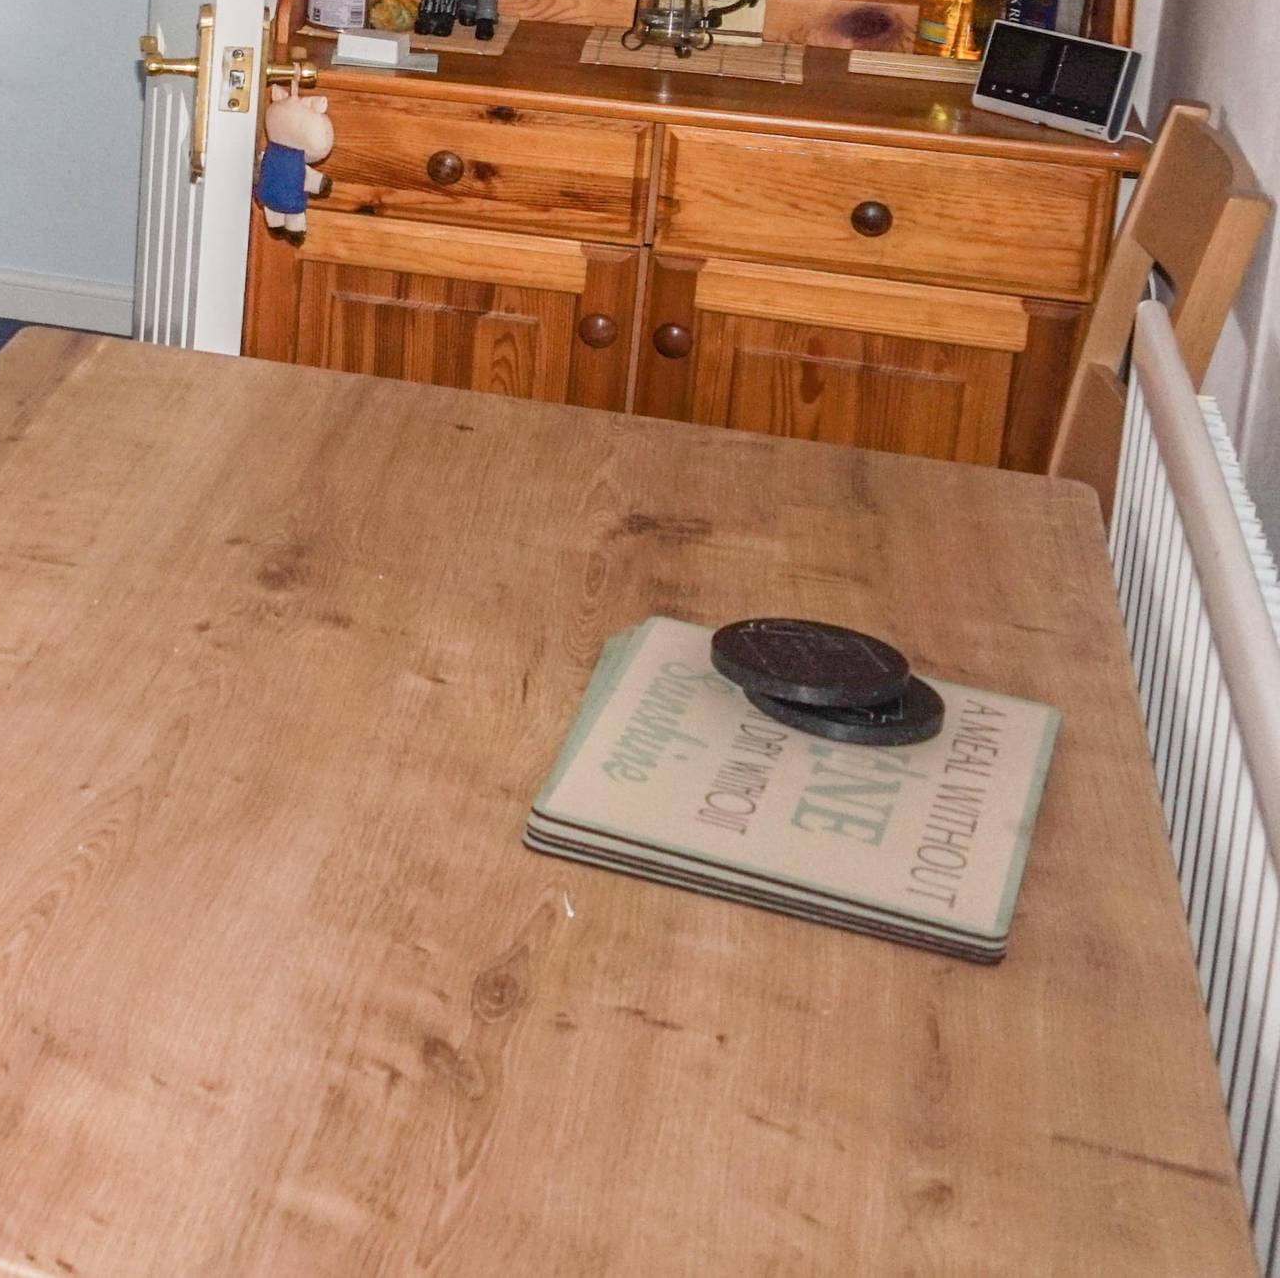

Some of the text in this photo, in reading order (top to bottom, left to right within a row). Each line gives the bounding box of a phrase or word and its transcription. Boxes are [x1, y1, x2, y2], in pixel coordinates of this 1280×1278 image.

[1007, 7, 1023, 23] RU
[601, 662, 737, 784] Sunshine
[695, 758, 775, 836] WITHOUT
[905, 698, 1007, 909] A MEAL WITHOUT
